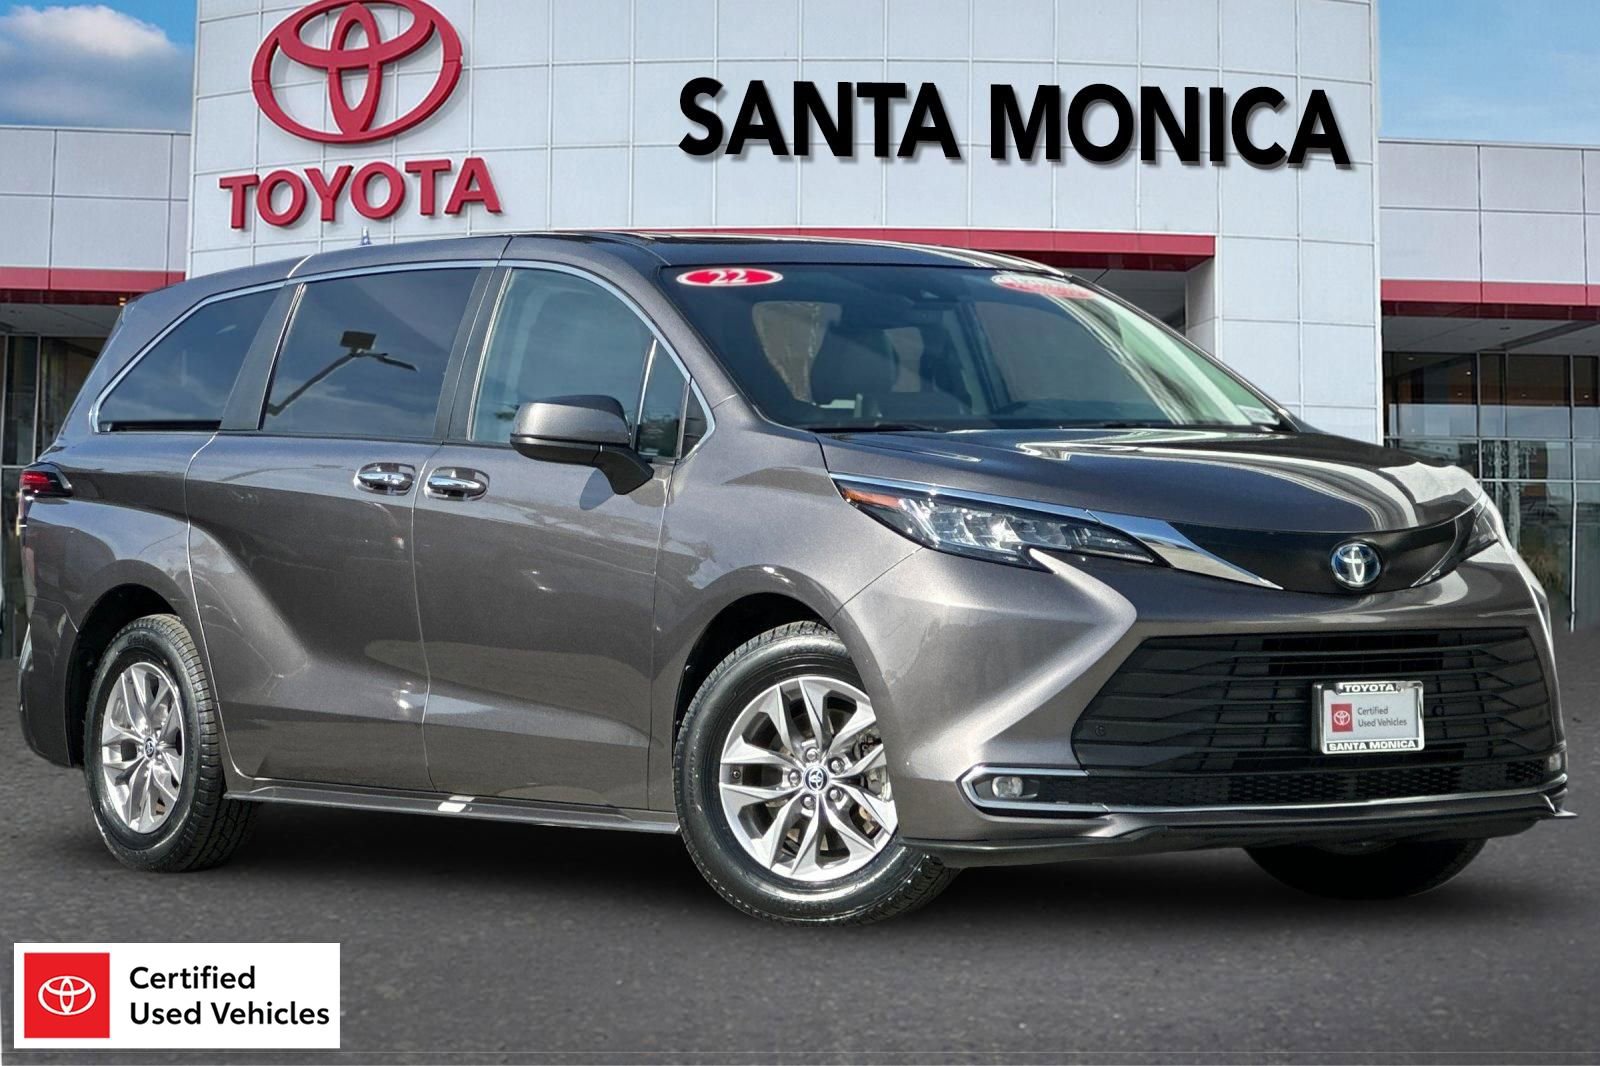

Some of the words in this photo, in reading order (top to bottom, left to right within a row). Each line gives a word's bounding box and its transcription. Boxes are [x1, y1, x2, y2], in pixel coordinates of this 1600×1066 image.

[679, 77, 960, 158] SANTA
[990, 83, 1351, 169] MONICA
[219, 157, 503, 230] TOYOTA
[707, 268, 749, 285] 22
[1345, 683, 1394, 692] TOYOTA
[1357, 707, 1389, 716] Certified
[1358, 718, 1377, 728] Used
[1378, 718, 1407, 727] Vehicles
[1328, 742, 1367, 752] SANTA
[1369, 740, 1416, 750] MONICA
